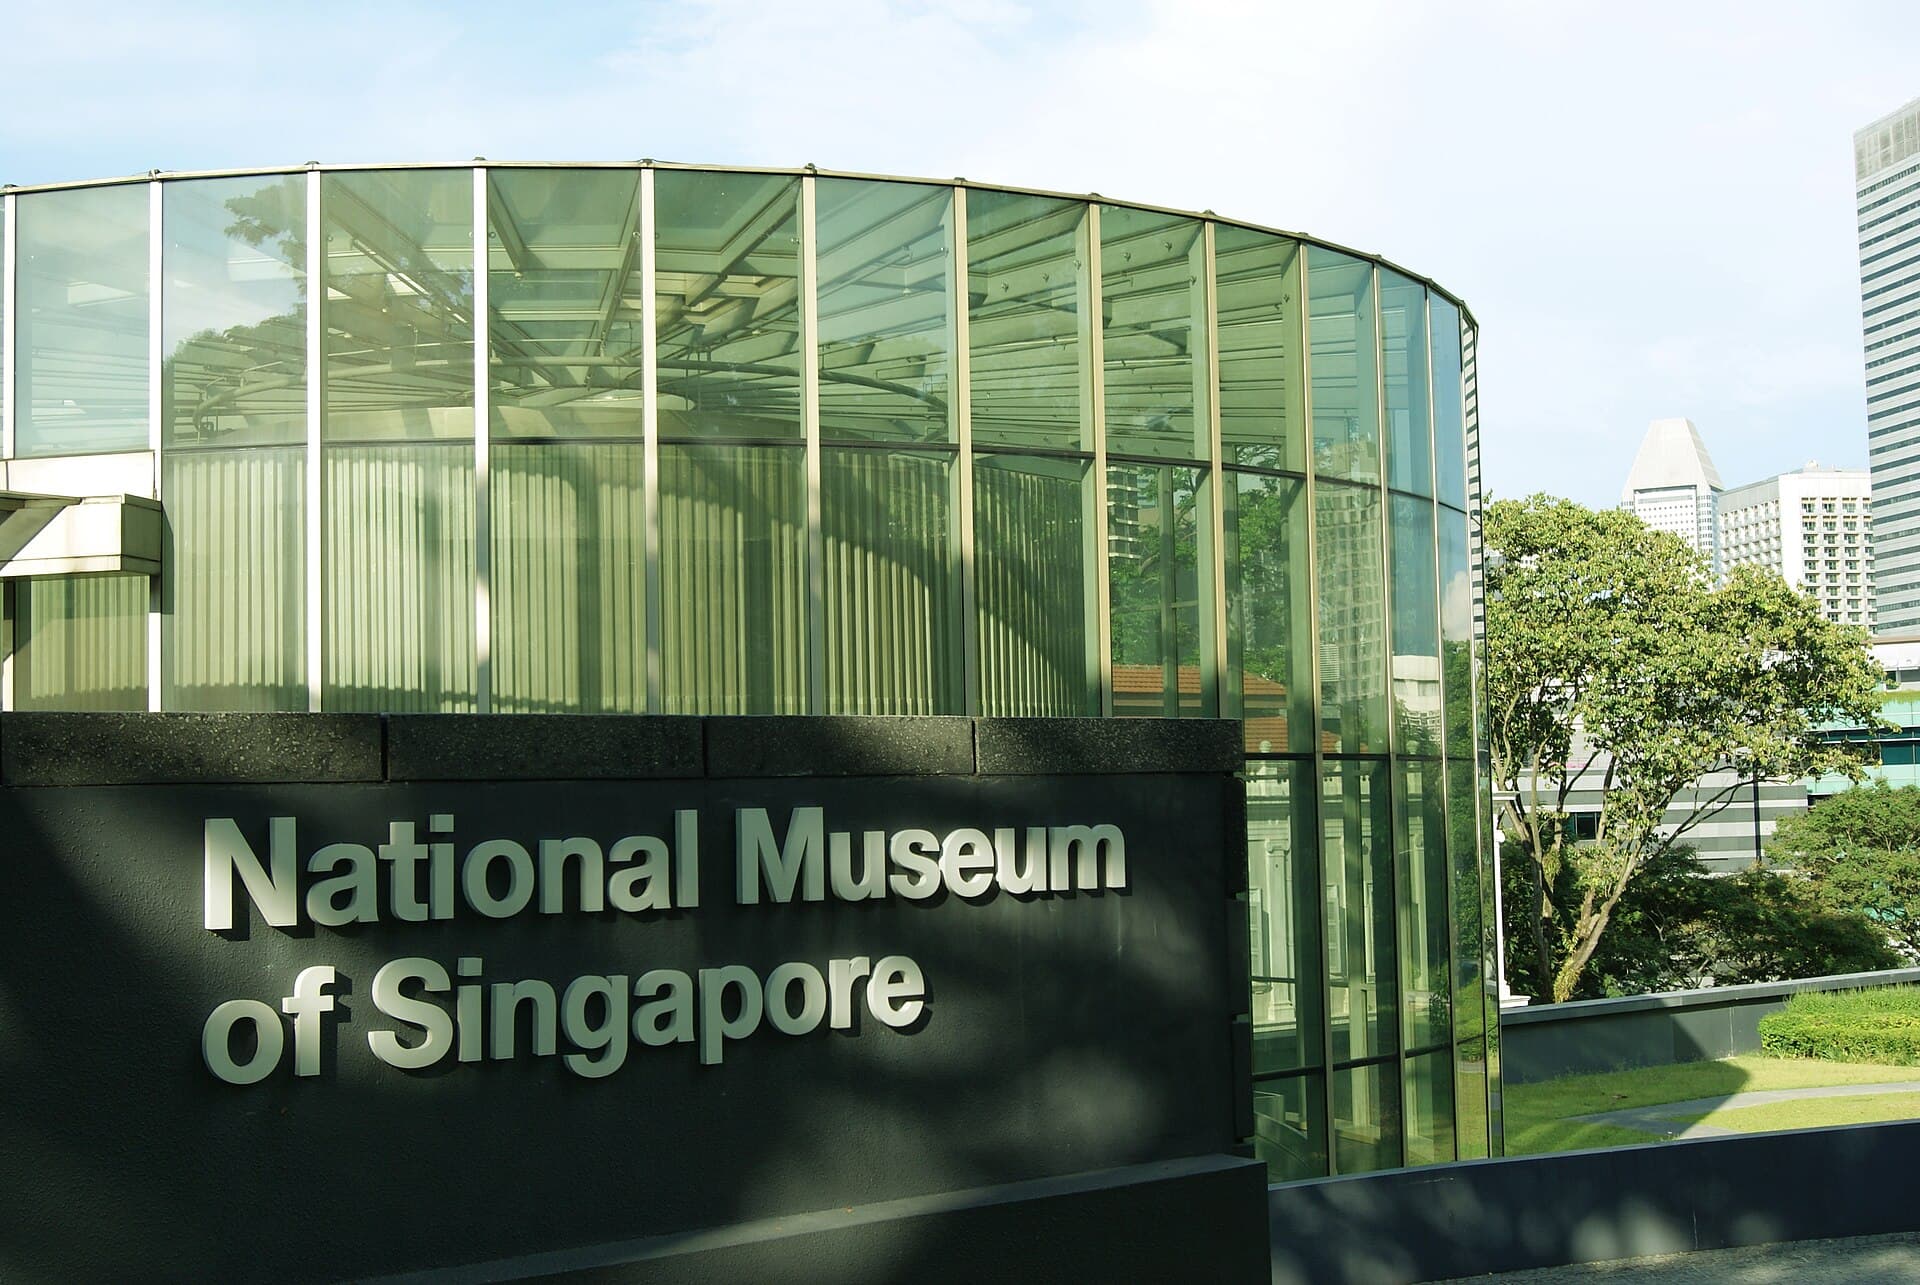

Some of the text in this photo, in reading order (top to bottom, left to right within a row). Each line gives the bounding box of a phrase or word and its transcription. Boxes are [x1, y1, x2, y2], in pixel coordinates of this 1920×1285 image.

[203, 806, 1127, 930] National Museum
[202, 955, 925, 1085] of Singapore
